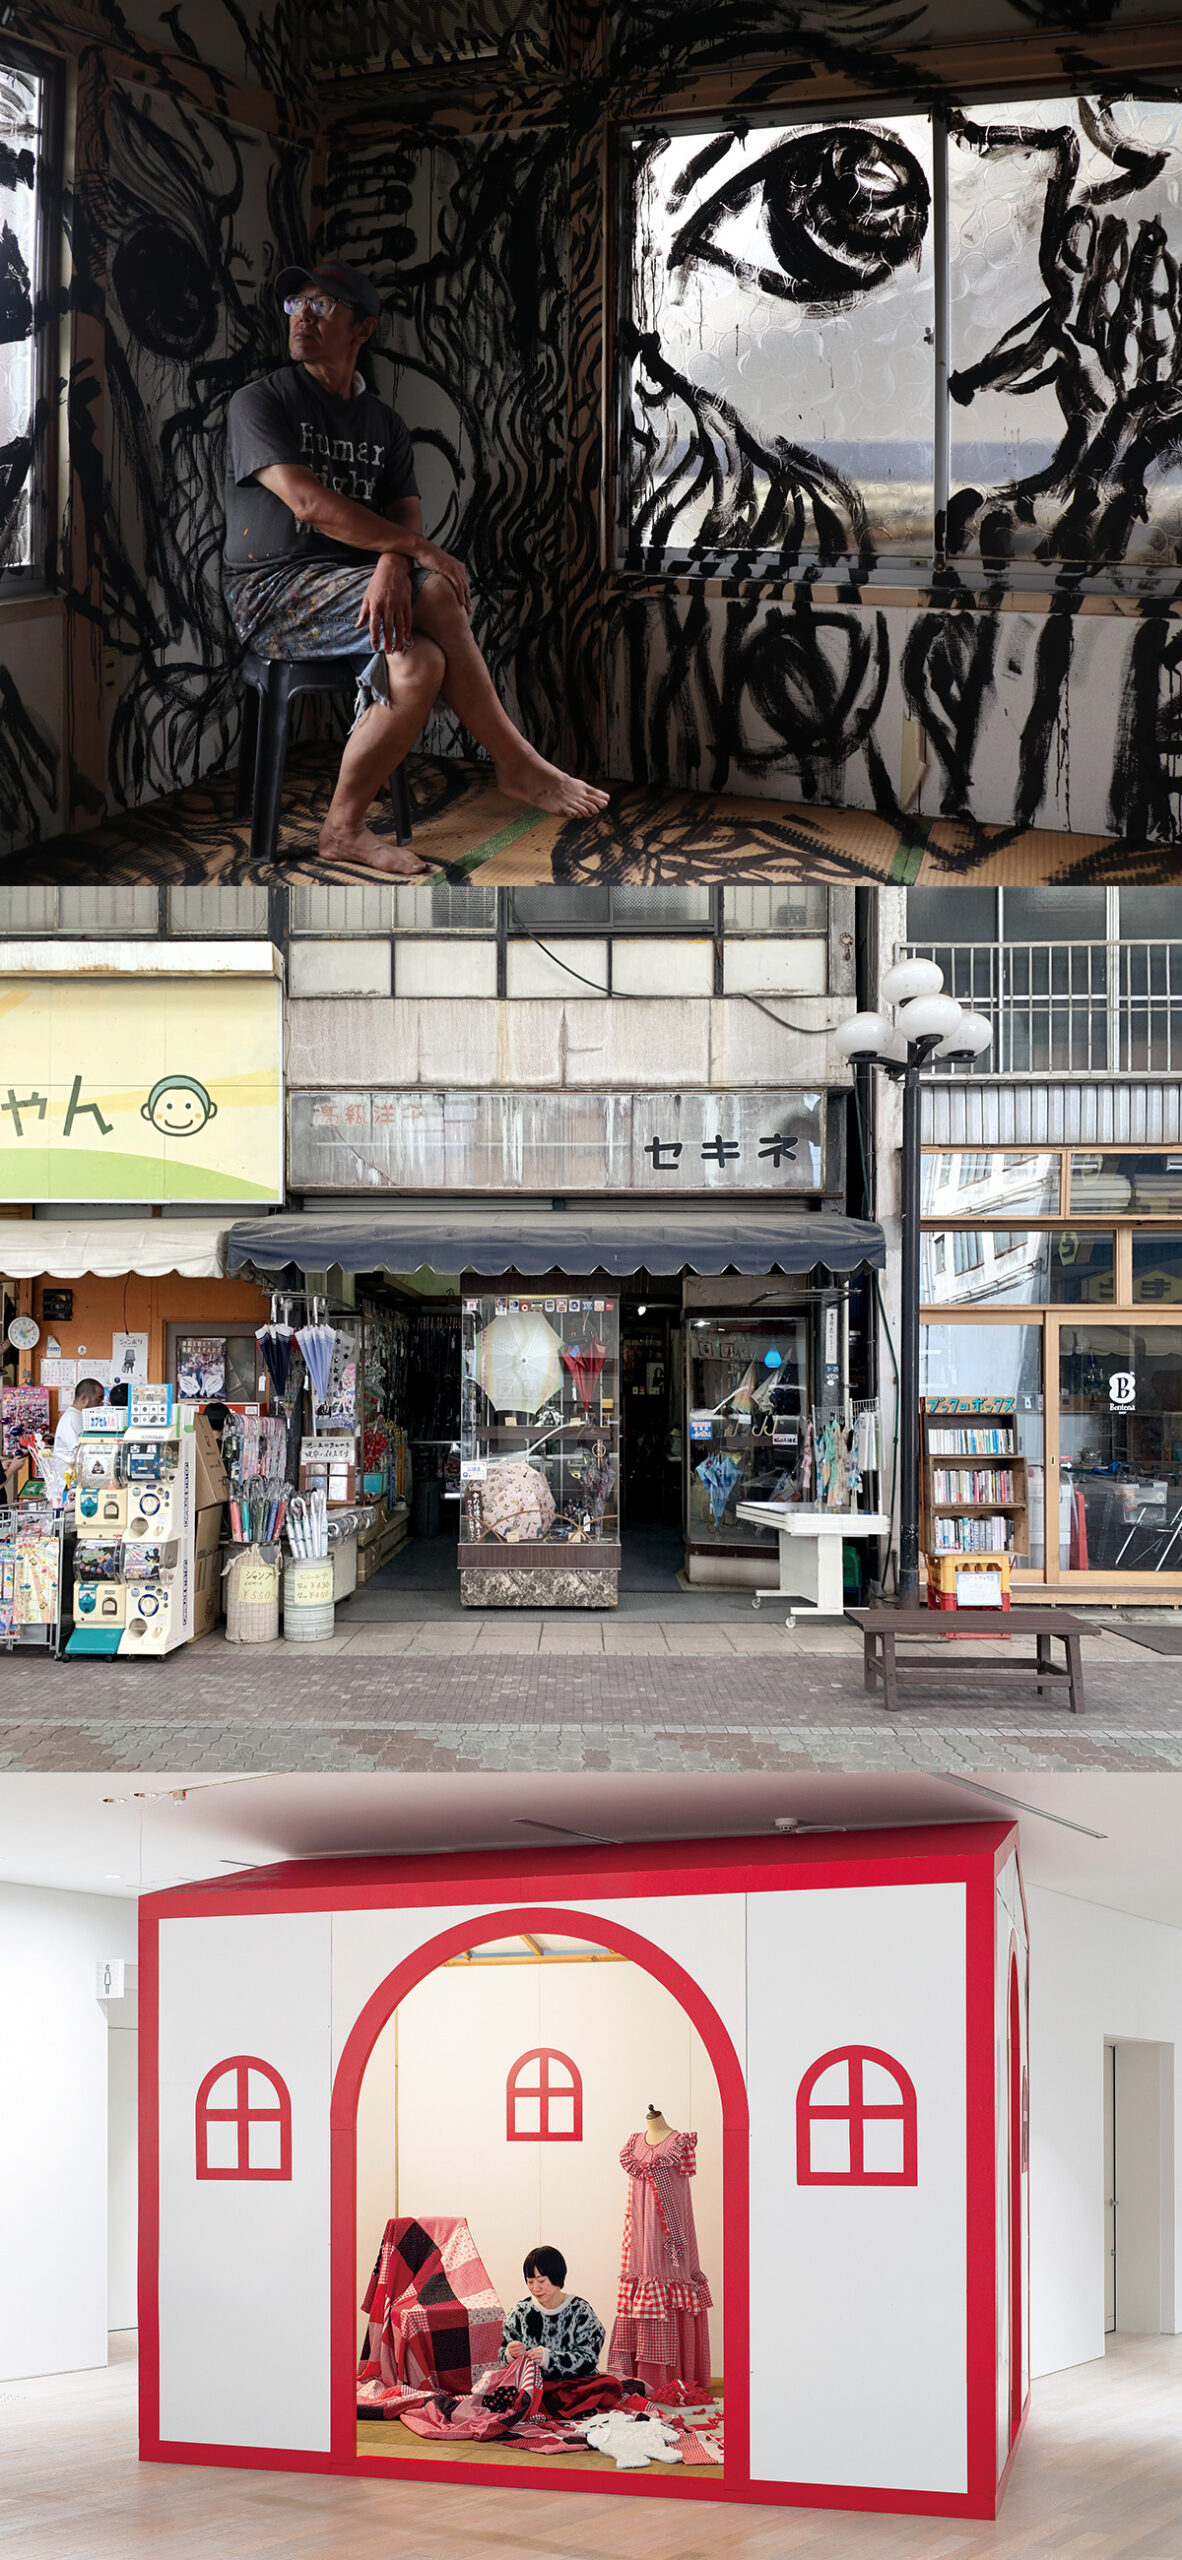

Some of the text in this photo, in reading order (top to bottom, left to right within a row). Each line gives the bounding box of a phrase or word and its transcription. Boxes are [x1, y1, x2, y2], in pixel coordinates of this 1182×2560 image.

[644, 1133, 799, 1170] セキネ
[927, 1397, 1016, 1413] ブックのボックス
